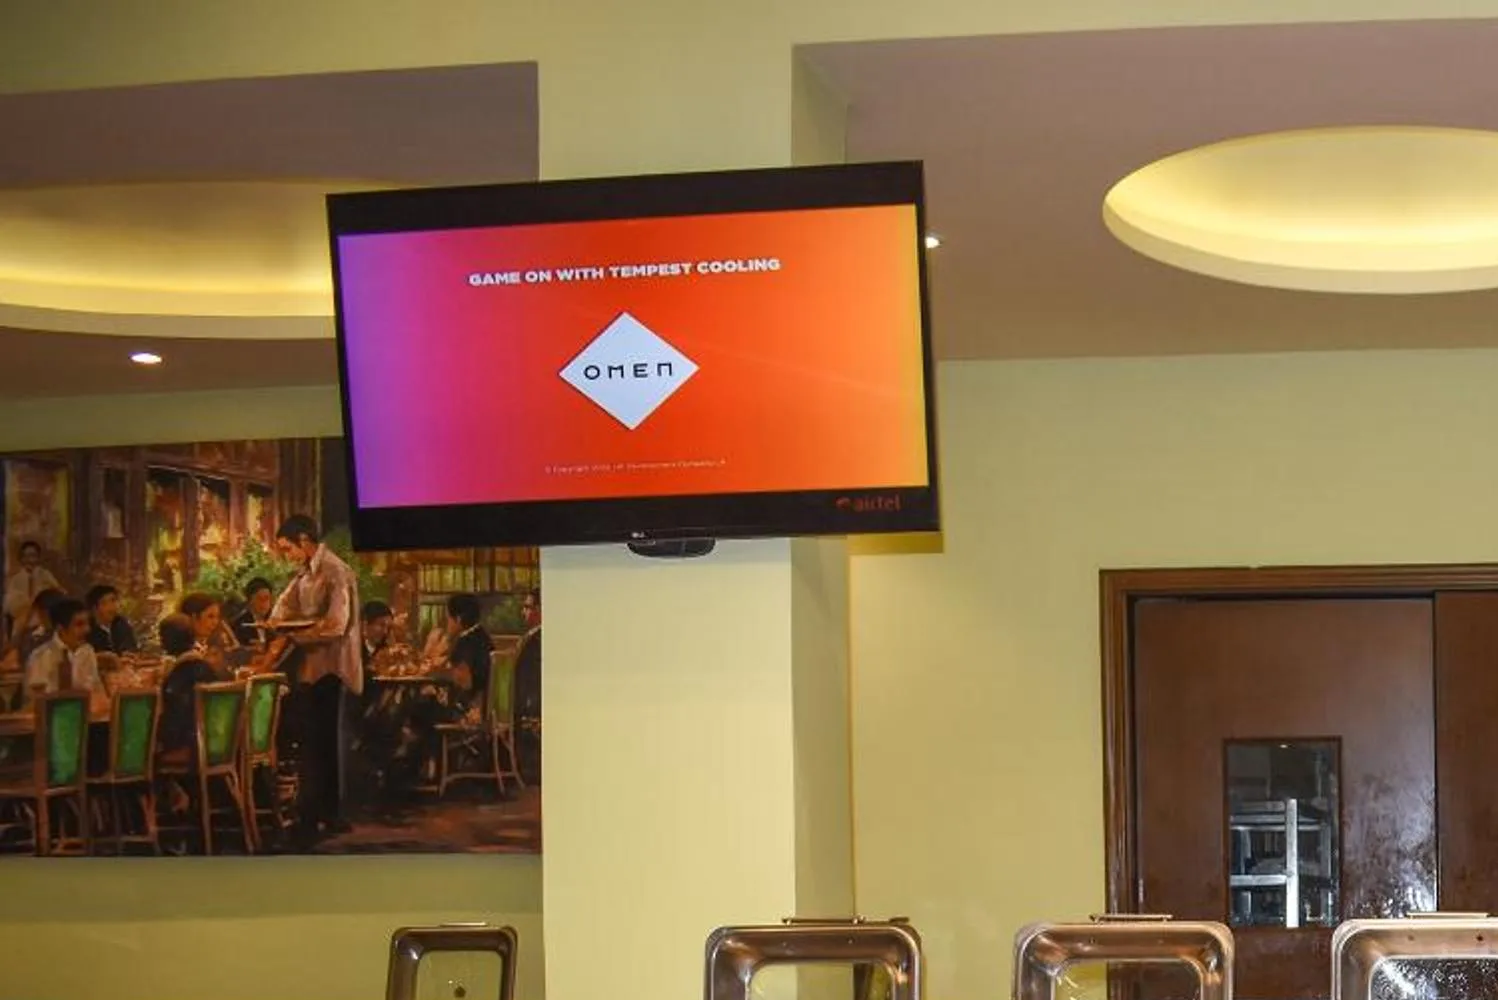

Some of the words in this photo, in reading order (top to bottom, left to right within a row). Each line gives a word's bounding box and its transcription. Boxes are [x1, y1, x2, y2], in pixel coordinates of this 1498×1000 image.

[469, 270, 520, 287] GAME
[525, 269, 552, 284] ON
[556, 265, 604, 282] WITH
[609, 261, 691, 279] TEMPEST
[696, 257, 781, 274] COOLING
[583, 361, 674, 381] OMEN
